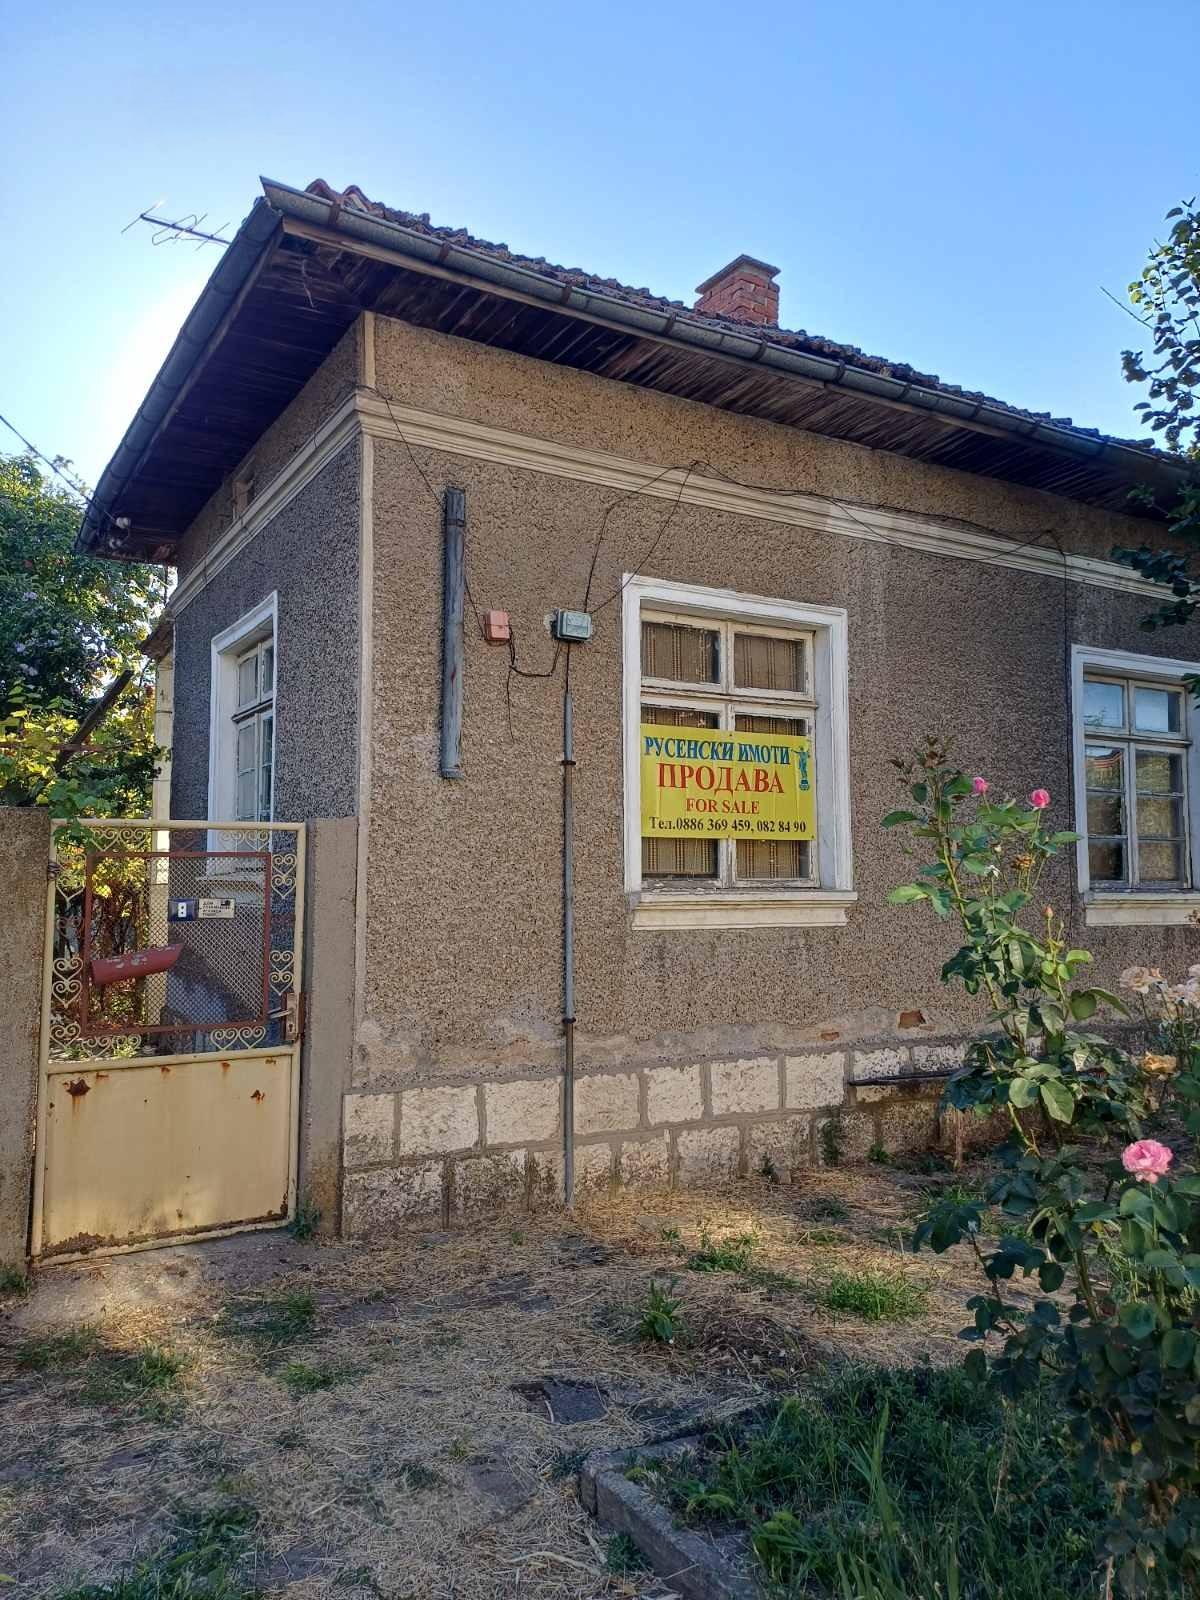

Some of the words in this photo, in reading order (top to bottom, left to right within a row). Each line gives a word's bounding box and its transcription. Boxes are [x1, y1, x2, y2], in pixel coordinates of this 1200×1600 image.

[644, 736, 734, 761] РУСЕНСКИ
[738, 743, 791, 765] ИМОТИ
[656, 763, 785, 797] ПРОДАВА
[686, 798, 717, 813] FOR
[721, 800, 760, 814] SALE
[707, 818, 728, 831] 369
[731, 819, 755, 834] 459,
[757, 820, 776, 832] 082
[778, 820, 791, 832] 84
[793, 820, 806, 833] 90
